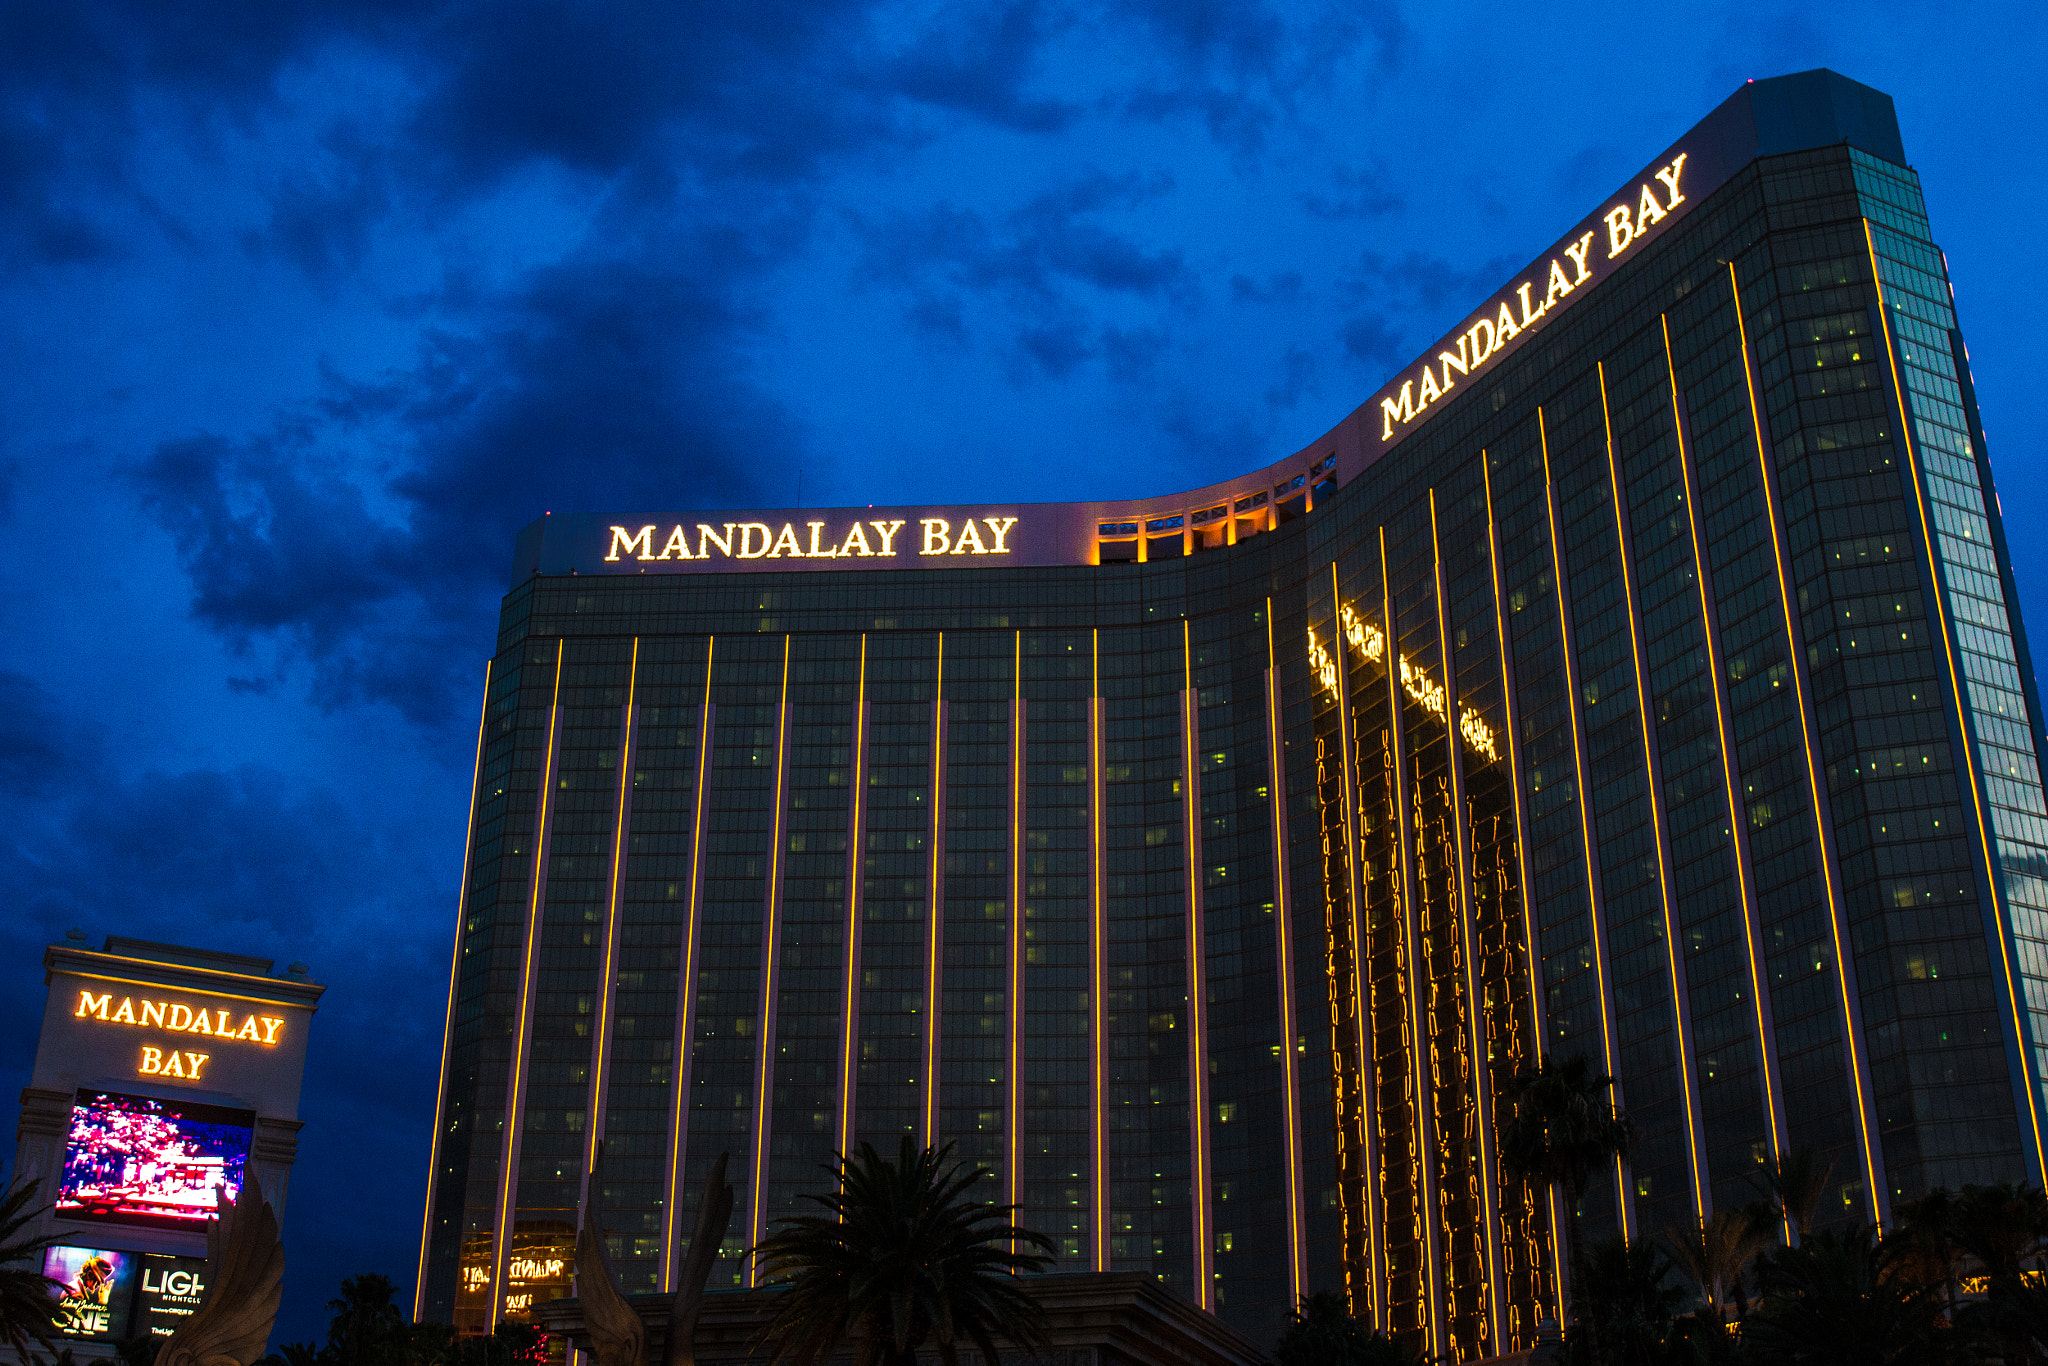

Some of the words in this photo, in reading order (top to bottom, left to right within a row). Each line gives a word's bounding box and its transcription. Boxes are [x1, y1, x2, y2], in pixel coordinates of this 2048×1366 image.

[1380, 231, 1594, 441] MANDALAY
[1603, 152, 1688, 260] BAY
[604, 519, 906, 562] MANDALAY
[919, 517, 1018, 556] BAY
[74, 990, 285, 1044] MANDALAY
[138, 1046, 210, 1081] BAY
[141, 1268, 205, 1297] LIGH
[162, 1294, 202, 1304] NIGHTCLU
